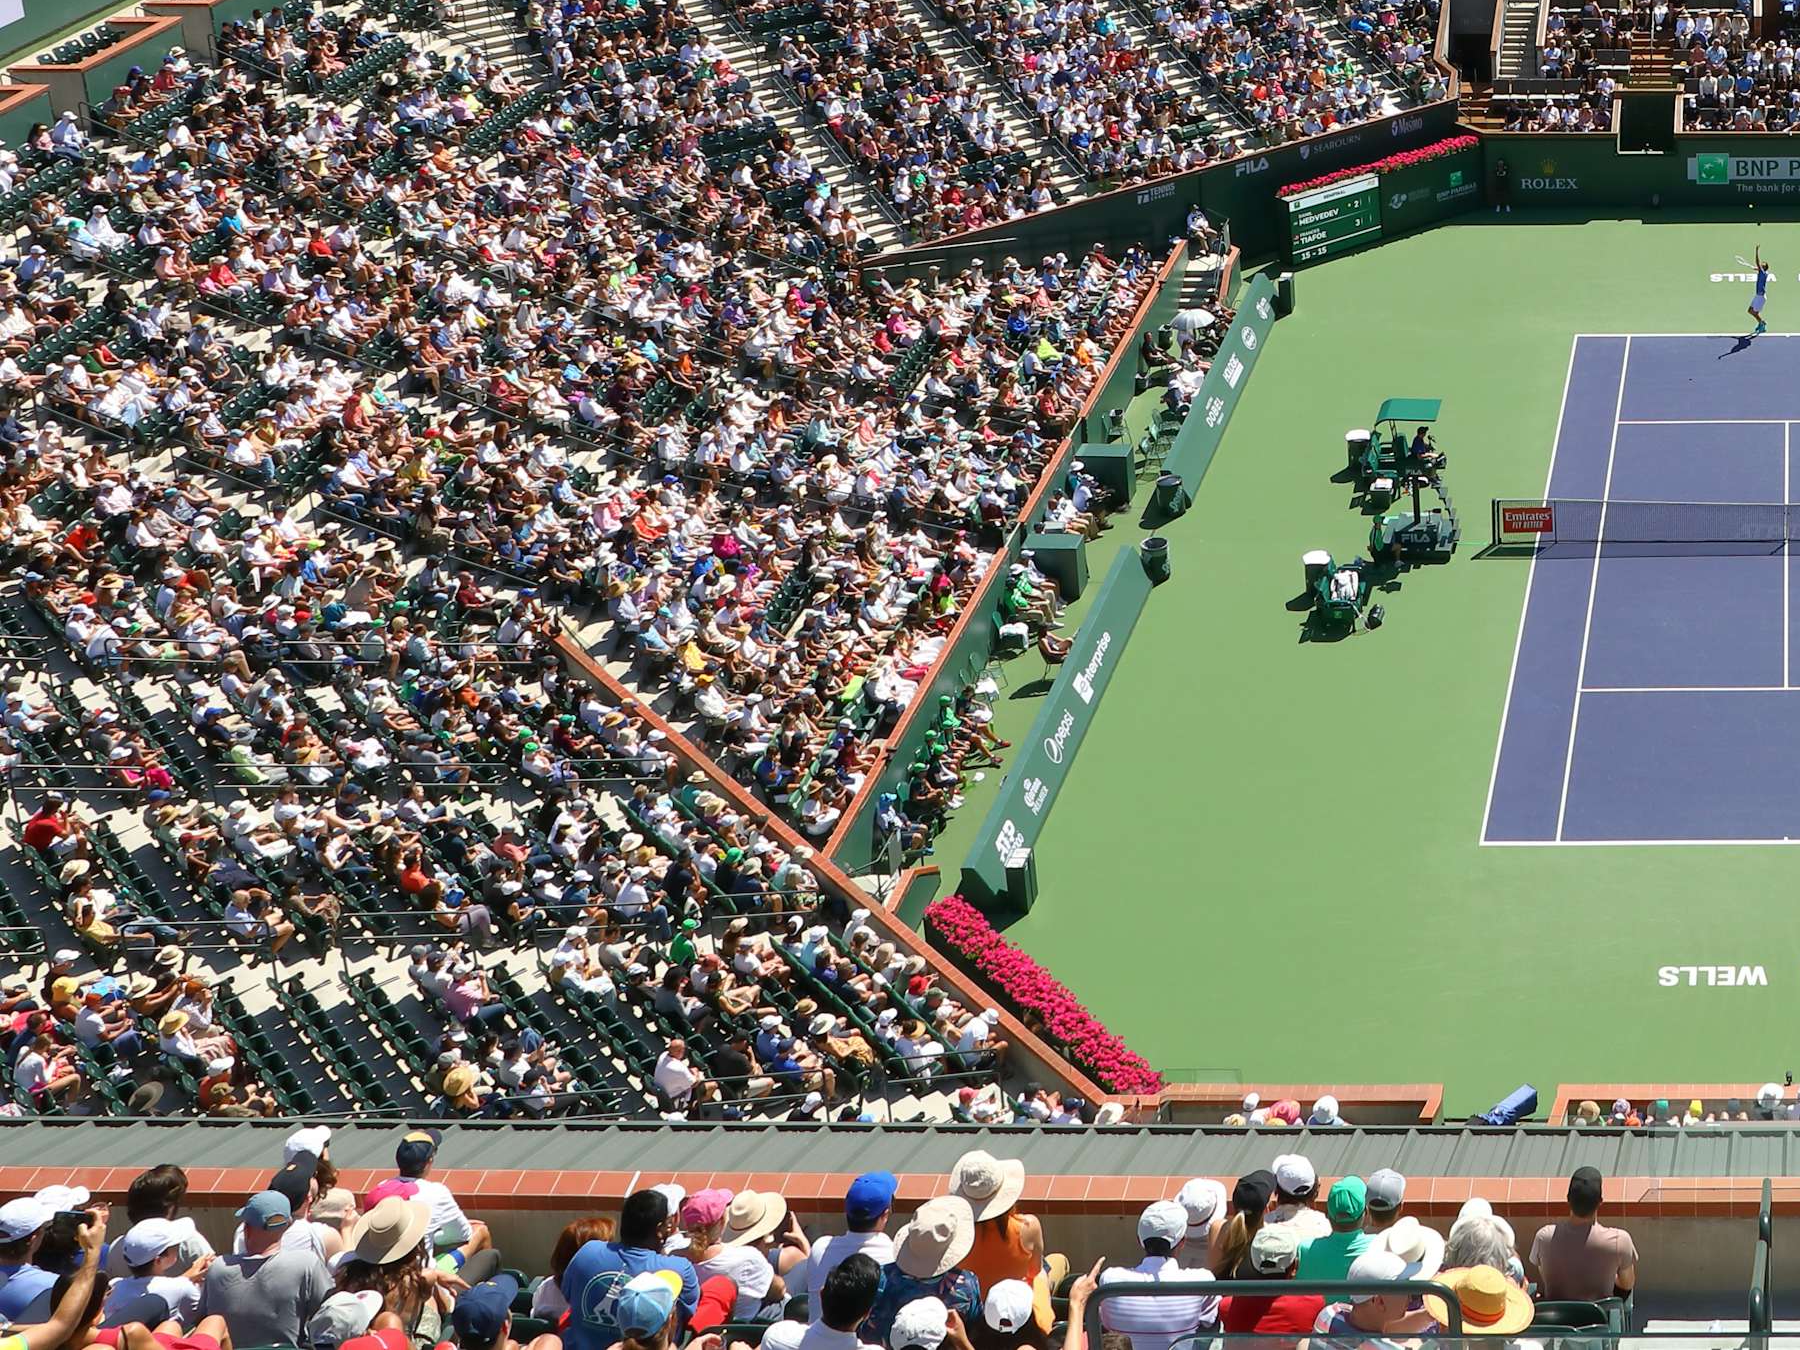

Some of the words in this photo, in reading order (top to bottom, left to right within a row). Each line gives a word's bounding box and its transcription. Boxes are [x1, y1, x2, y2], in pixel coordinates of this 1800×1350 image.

[1313, 134, 1361, 154] SEABOURN
[1235, 157, 1269, 178] FILA
[1735, 159, 1779, 177] BNP
[1150, 182, 1175, 196] TENNIS
[1520, 178, 1578, 190] ROLEX
[1736, 183, 1751, 192] The
[1756, 183, 1779, 192] bank
[1781, 183, 1795, 194] for
[1299, 208, 1339, 226] MEDVEDEV
[1354, 200, 1359, 208] 2
[1300, 231, 1327, 245] TIAFOE
[1355, 219, 1360, 227] 3
[1317, 246, 1327, 256] 15
[1206, 396, 1225, 428] DOBEL
[1505, 512, 1550, 521] Emirates
[1401, 533, 1430, 543] FILA
[1054, 708, 1074, 750] pepsi
[995, 819, 1016, 863] ATP
[1658, 964, 1768, 986] WELLS
